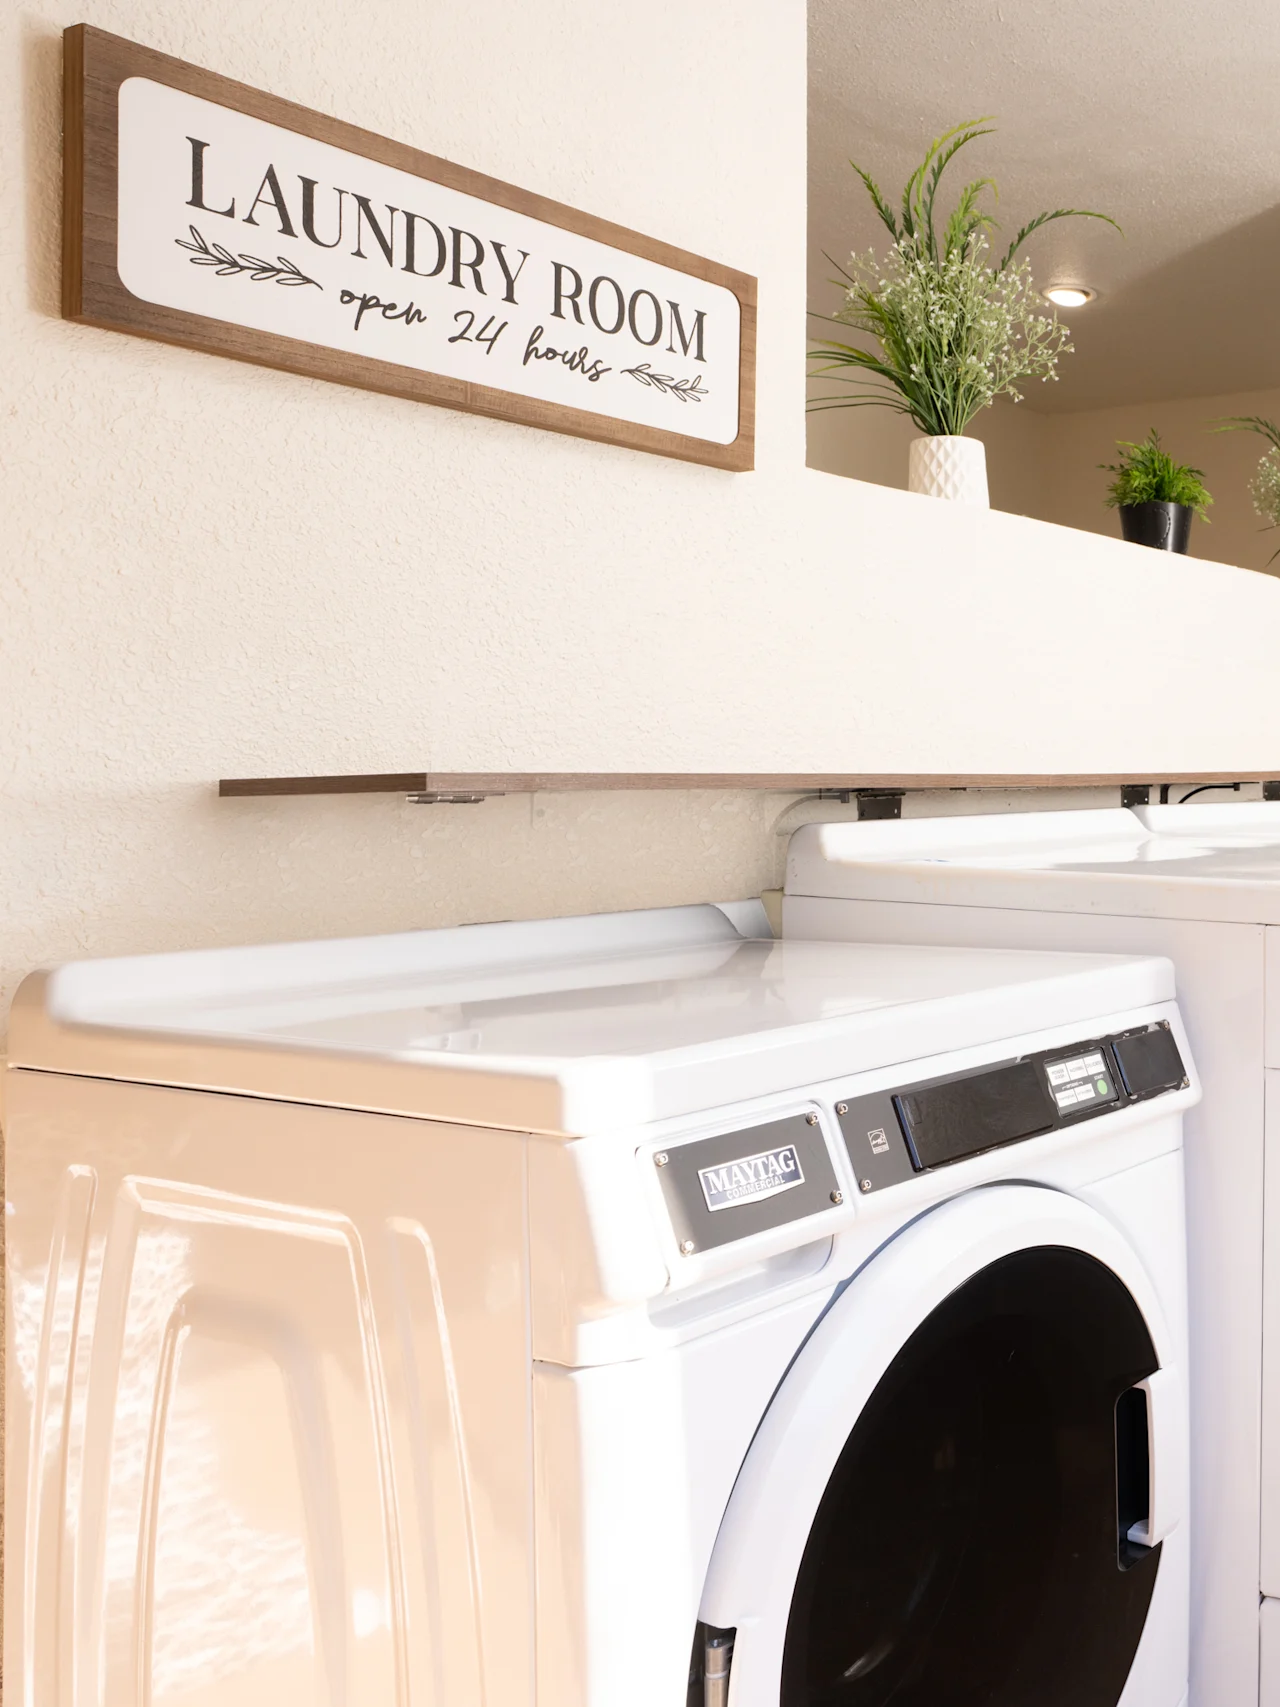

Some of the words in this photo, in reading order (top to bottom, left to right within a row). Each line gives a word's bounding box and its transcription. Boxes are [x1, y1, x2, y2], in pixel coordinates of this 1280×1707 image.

[185, 135, 531, 305] LAUNDRY
[550, 260, 708, 363] ROOM
[339, 289, 427, 331] open
[447, 310, 509, 355] 24
[523, 325, 612, 382] hours
[705, 1150, 796, 1195] MAYTAG
[726, 1174, 786, 1200] COMMERCIAL
